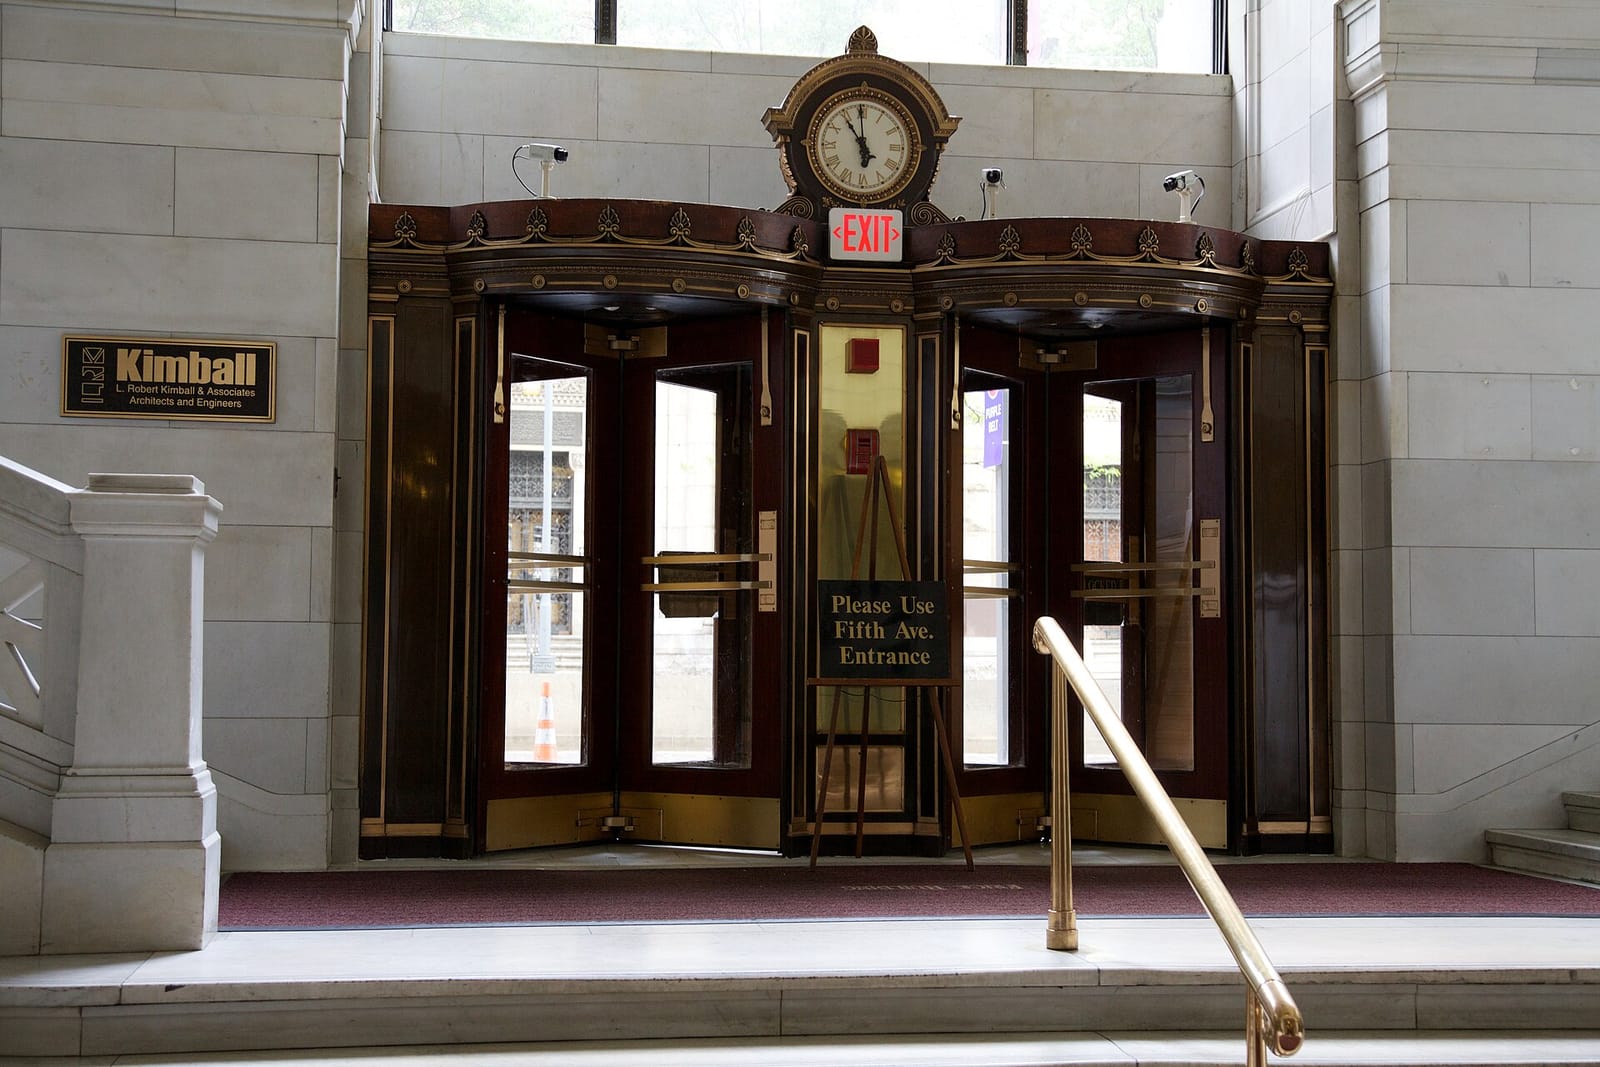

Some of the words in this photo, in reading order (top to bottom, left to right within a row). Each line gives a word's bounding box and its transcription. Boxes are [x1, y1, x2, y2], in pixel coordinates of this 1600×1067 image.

[829, 123, 841, 134] X
[825, 140, 836, 150] IX
[889, 144, 901, 152] III
[859, 174, 868, 185] VI
[876, 171, 885, 182] V
[843, 214, 893, 253] EXIT
[117, 348, 256, 386] Kimball
[116, 384, 125, 393] L.
[128, 384, 158, 394] Robert
[161, 385, 195, 395] Kimball
[197, 387, 204, 395] &
[206, 387, 256, 397] Associates
[129, 397, 174, 406] Architects
[177, 398, 194, 407] and
[196, 398, 242, 409] Engineers
[832, 595, 891, 614] Please
[900, 596, 935, 614] Use
[834, 621, 885, 639] Fifth
[895, 621, 934, 640] Ave.
[840, 646, 931, 665] Entrance
